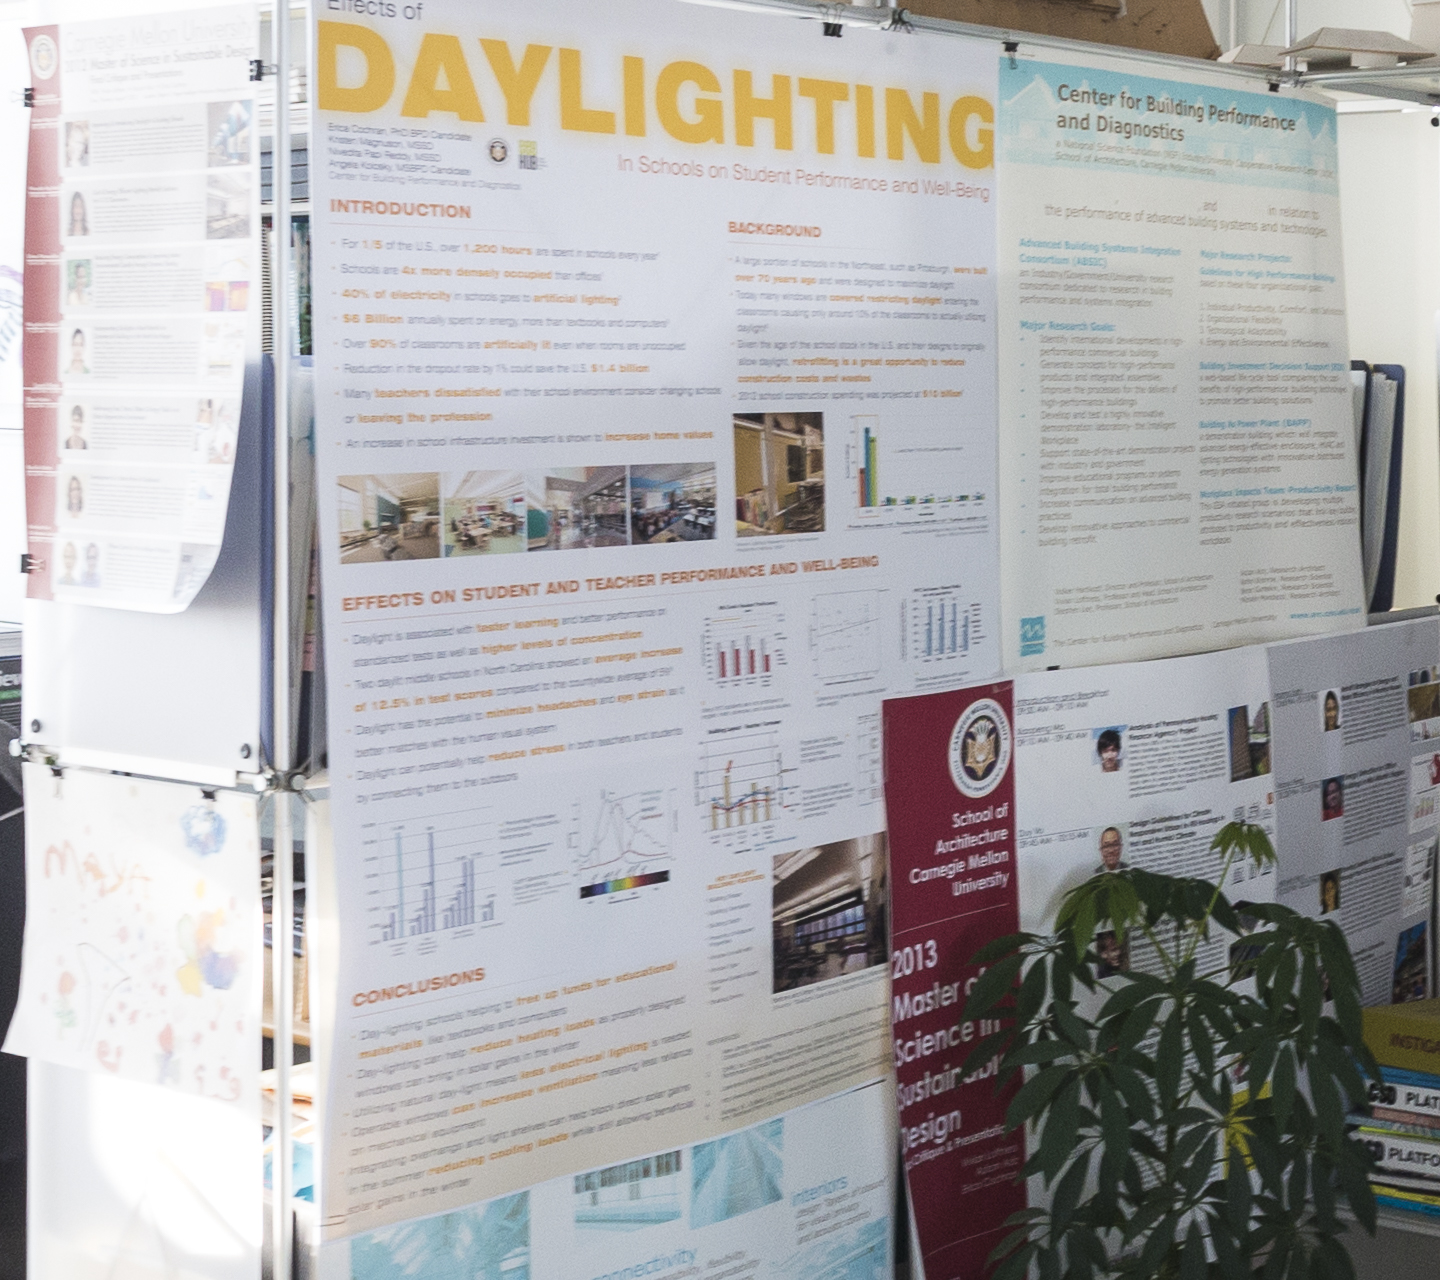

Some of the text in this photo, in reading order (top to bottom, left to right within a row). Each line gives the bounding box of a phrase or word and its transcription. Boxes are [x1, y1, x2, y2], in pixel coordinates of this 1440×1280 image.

[403, 1, 423, 22] of
[316, 20, 995, 170] DAYLIGHTING
[1056, 83, 1296, 132] Center for Building Performance
[1057, 113, 1185, 142] and Diagnostics
[617, 154, 990, 202] In Schools on Student Performance and Well-Being
[330, 198, 471, 219] INTRODUCTION
[1065, 205, 1131, 222] performance
[728, 221, 822, 238] BACKGROUND
[502, 244, 532, 256] hours
[421, 267, 452, 277] more
[390, 289, 451, 302] electricity
[342, 555, 880, 612] EFFECTS ON STUDENT AND TEACHER PERFORMANCE AND WELL-BEING
[952, 801, 1009, 829] School of
[934, 828, 1009, 856] Architecture
[909, 849, 1009, 884] Carnegie Mellon
[952, 871, 1010, 897] University
[892, 938, 938, 980] 2013
[352, 967, 486, 1008] CONCLUSIONS
[893, 982, 961, 1024] Master
[894, 1020, 975, 1068] Science
